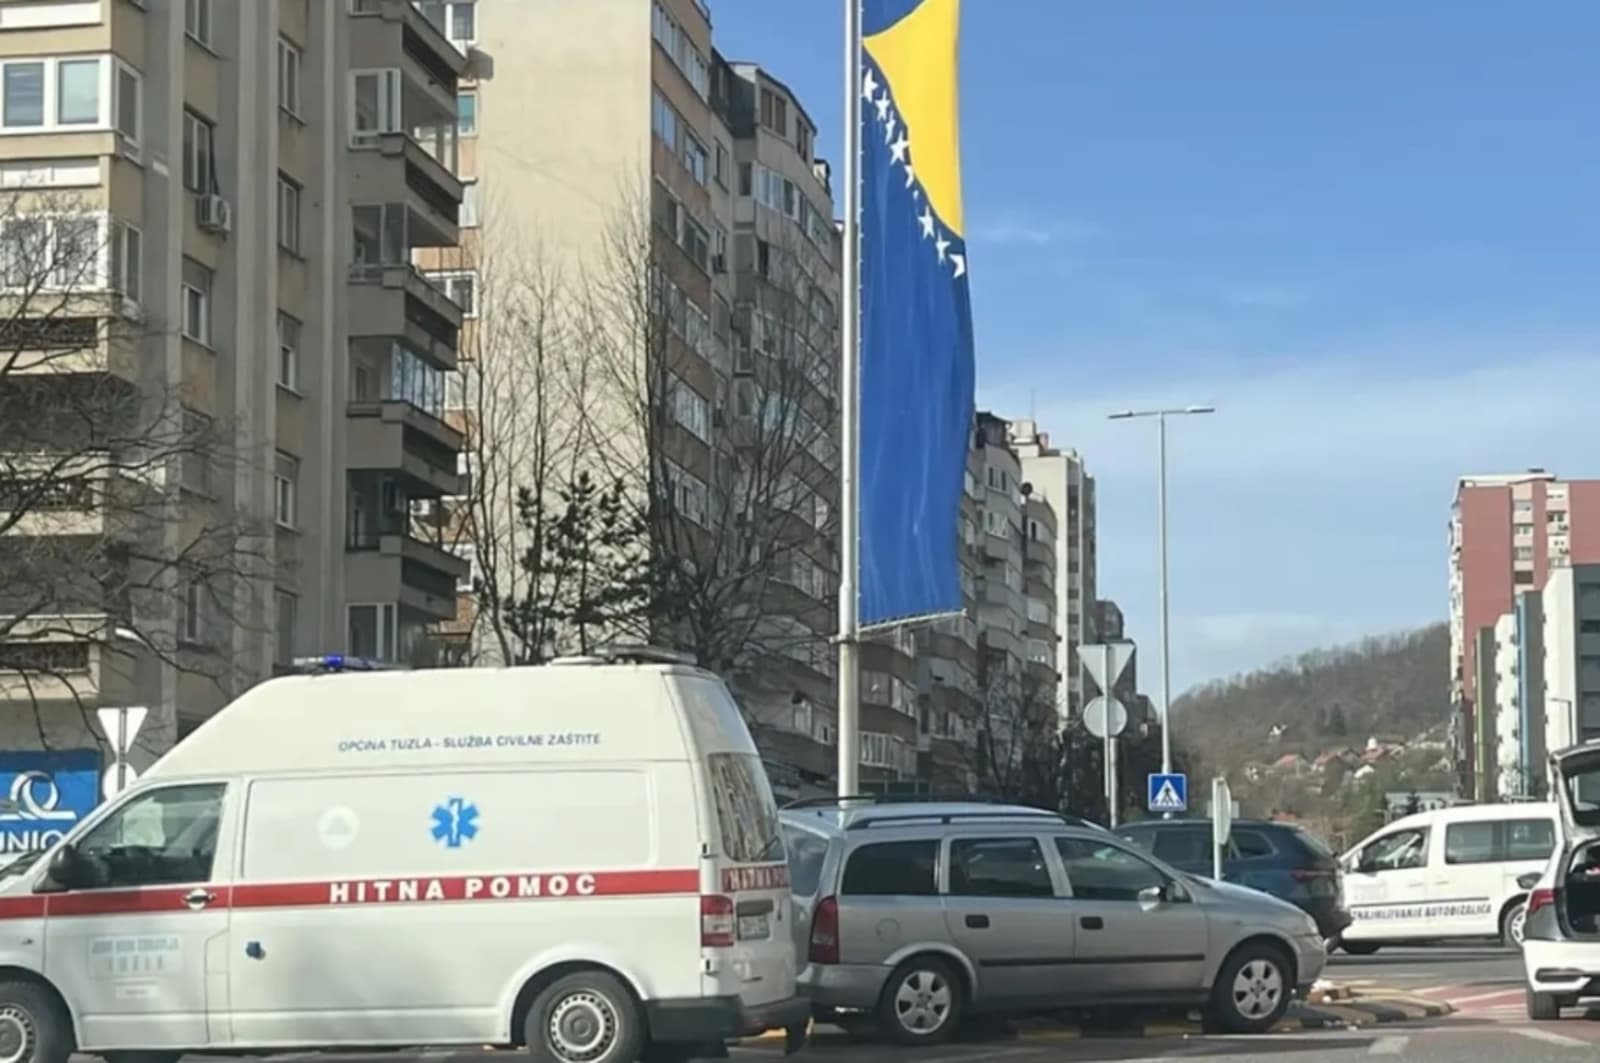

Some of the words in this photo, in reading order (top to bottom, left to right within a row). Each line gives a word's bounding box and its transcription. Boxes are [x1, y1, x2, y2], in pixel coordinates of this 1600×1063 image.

[391, 737, 433, 750] TUZLA
[496, 734, 544, 747] CIVILNE
[330, 878, 445, 903] HITNA
